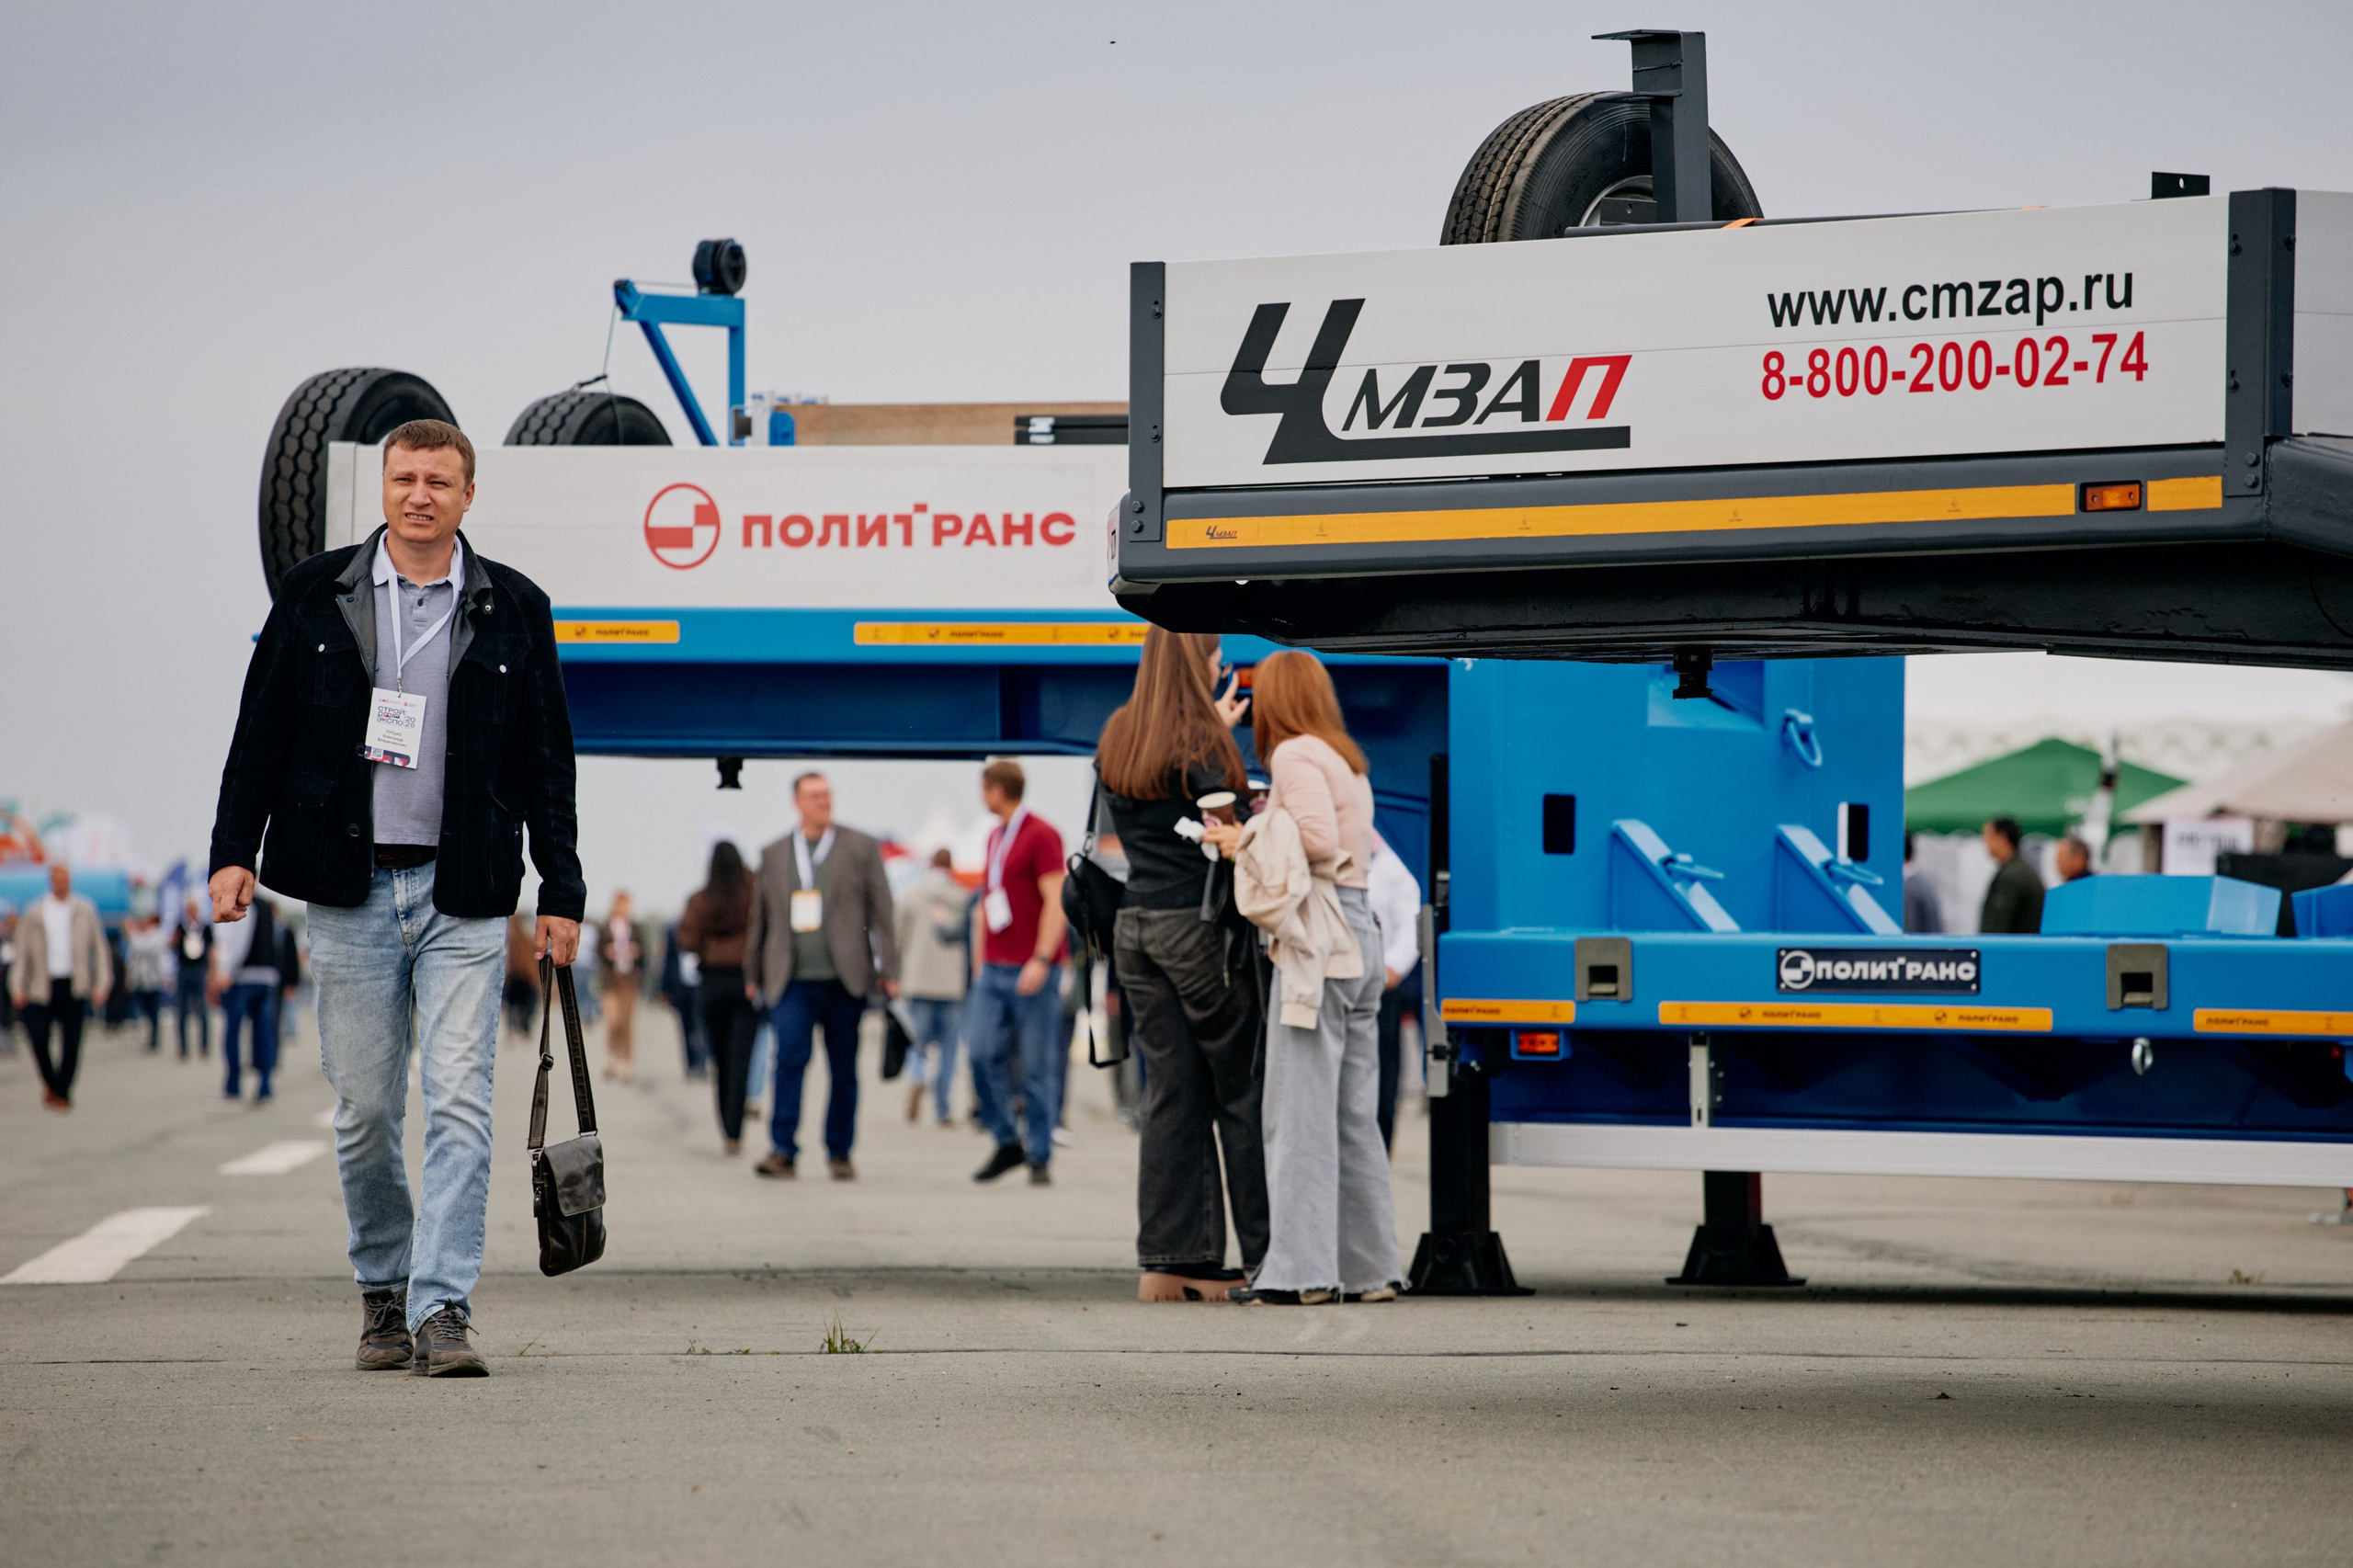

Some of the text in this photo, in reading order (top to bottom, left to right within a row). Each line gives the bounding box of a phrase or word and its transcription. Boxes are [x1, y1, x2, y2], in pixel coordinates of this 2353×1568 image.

[1768, 273, 2133, 326] www.cmzap.ru
[1220, 298, 1633, 465] ЧМЗАП
[1761, 331, 2149, 401] 8-800-200-02-74
[742, 503, 1076, 549] ПОЛИТРАНС
[1815, 957, 1976, 982] ПОЛИТРАНС
